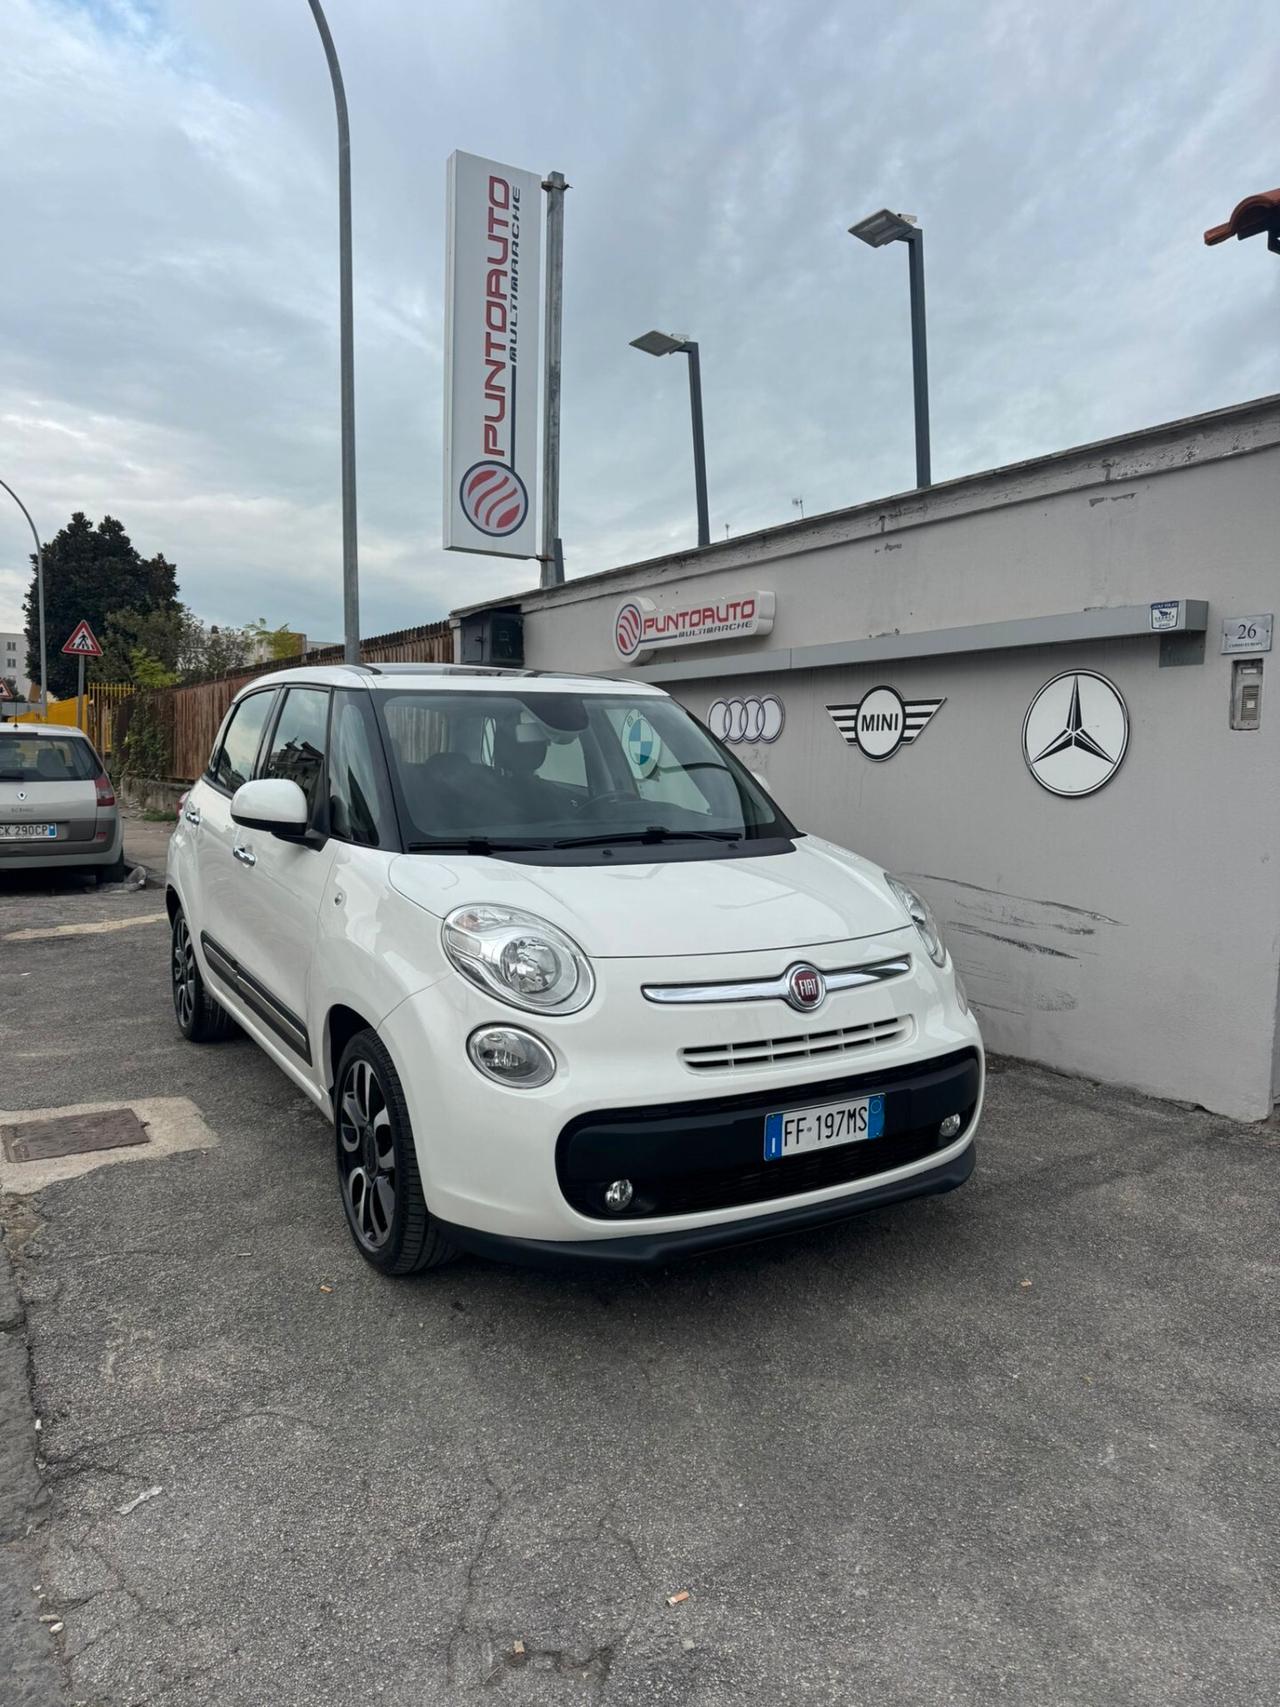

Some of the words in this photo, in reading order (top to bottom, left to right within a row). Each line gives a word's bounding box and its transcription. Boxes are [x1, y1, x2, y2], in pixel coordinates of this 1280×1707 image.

[509, 186, 521, 363] MULTIMARCHE
[484, 175, 510, 457] PUNTOAUTO
[643, 600, 755, 635] PUNTOAUTO
[678, 621, 753, 638] MULTIMARCHE
[1237, 623, 1257, 640] 26
[861, 713, 899, 732] MINI
[15, 825, 48, 836] 290CP
[799, 977, 818, 997] FIAT
